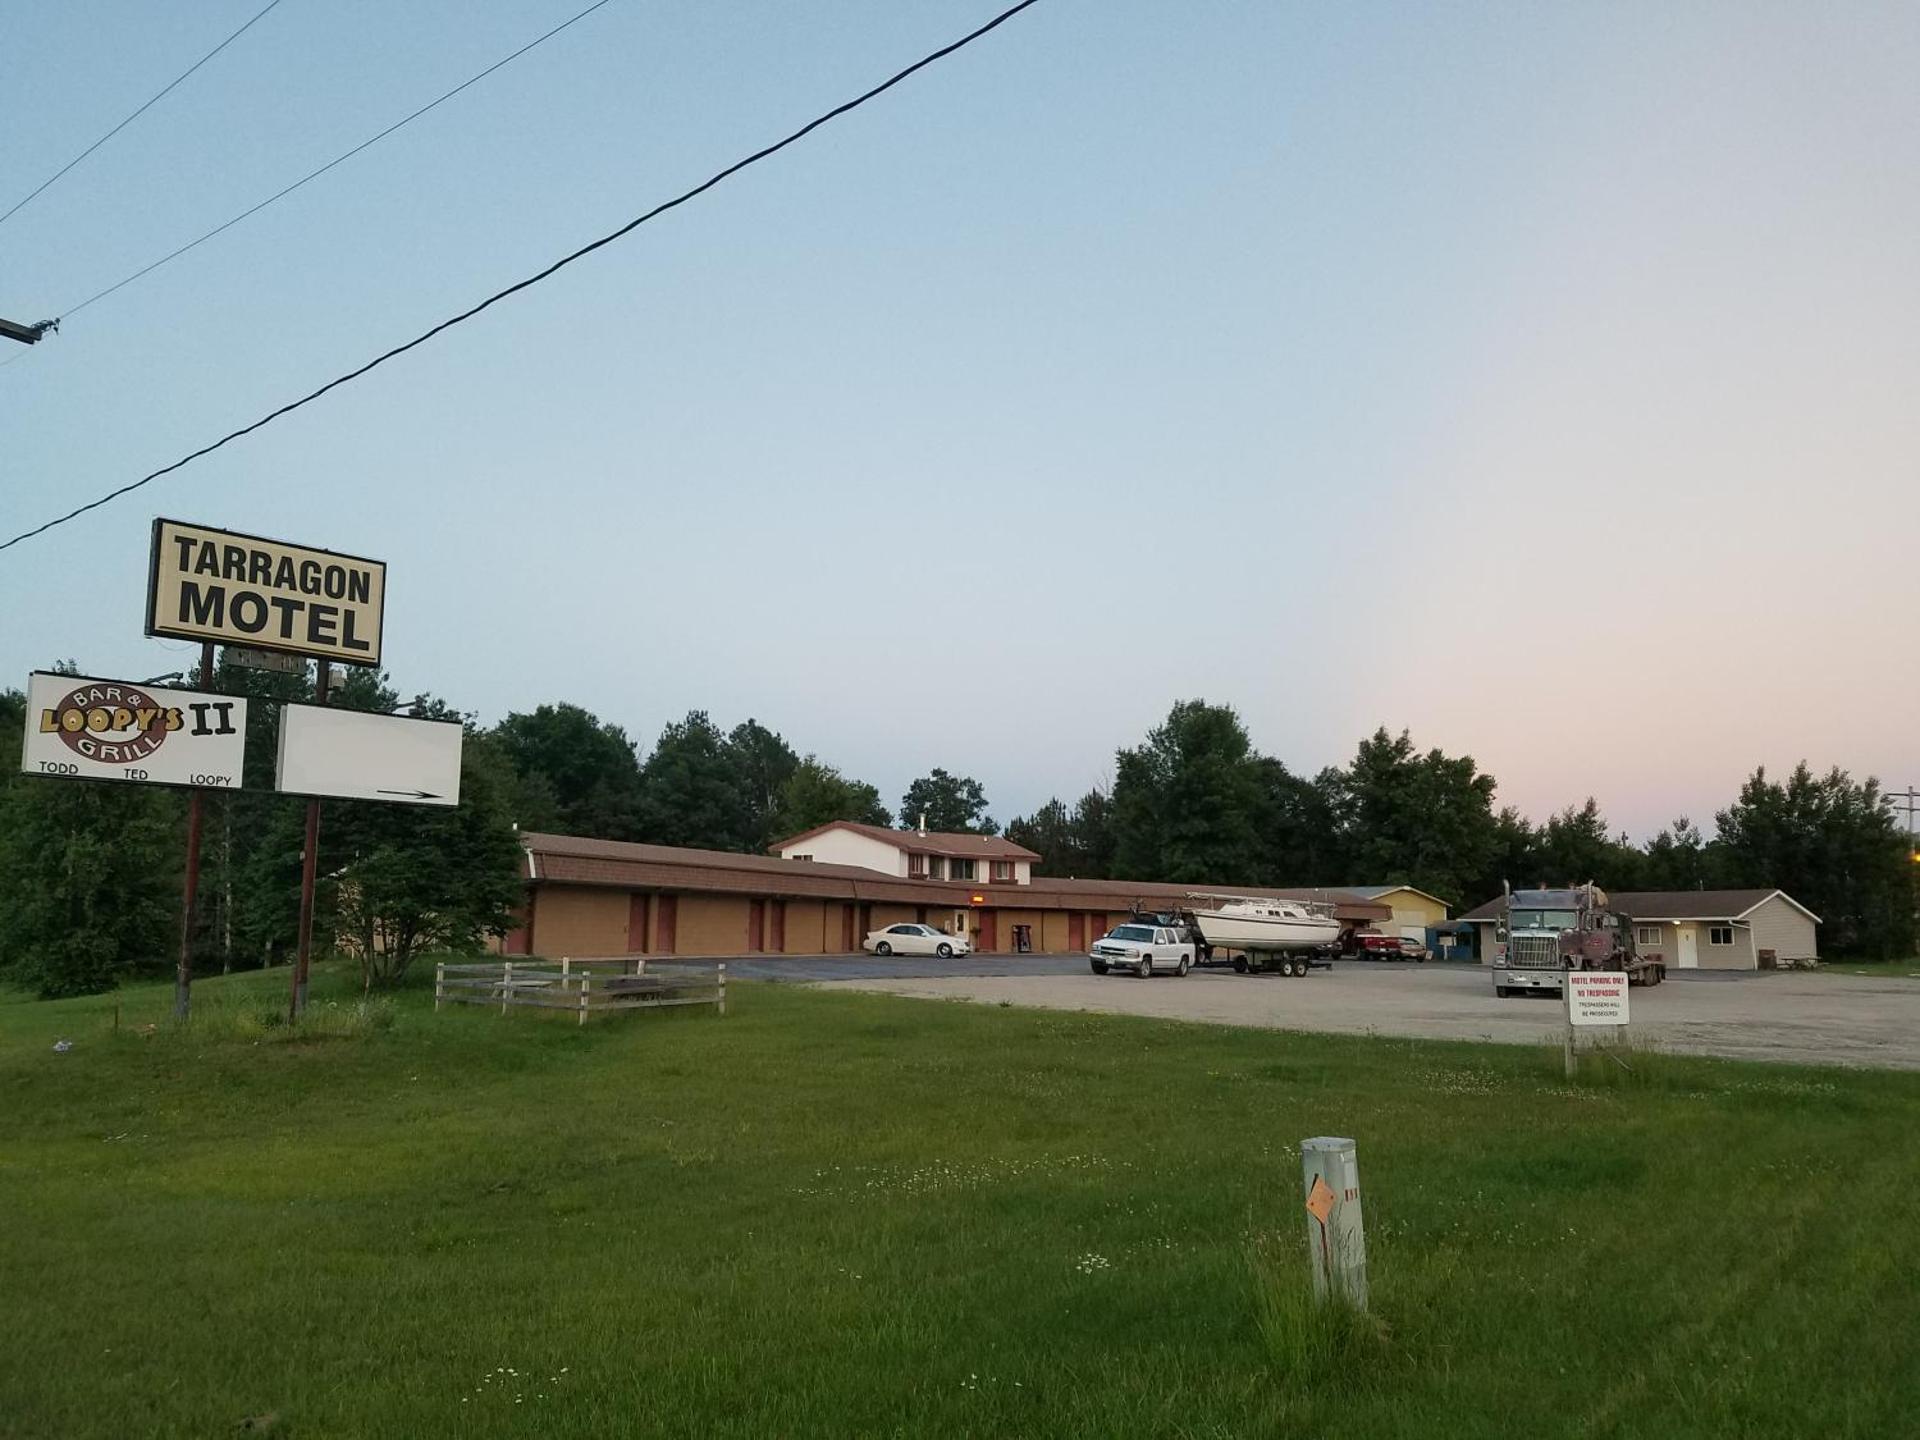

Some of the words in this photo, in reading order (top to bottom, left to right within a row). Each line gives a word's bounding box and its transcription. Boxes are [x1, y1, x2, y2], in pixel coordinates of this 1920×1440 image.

[174, 535, 370, 604] TARRAGON
[178, 581, 370, 651] MOTEL
[73, 687, 121, 707] BAR
[127, 694, 142, 706] &
[39, 707, 185, 733] LOOPY'S
[189, 702, 236, 736] II
[77, 736, 162, 761] GRILL
[39, 761, 79, 775] TODD
[124, 768, 148, 780] TED
[190, 774, 232, 786] LOOPY
[1577, 989, 1585, 997] NO
[1586, 989, 1620, 997] TRESPASSING
